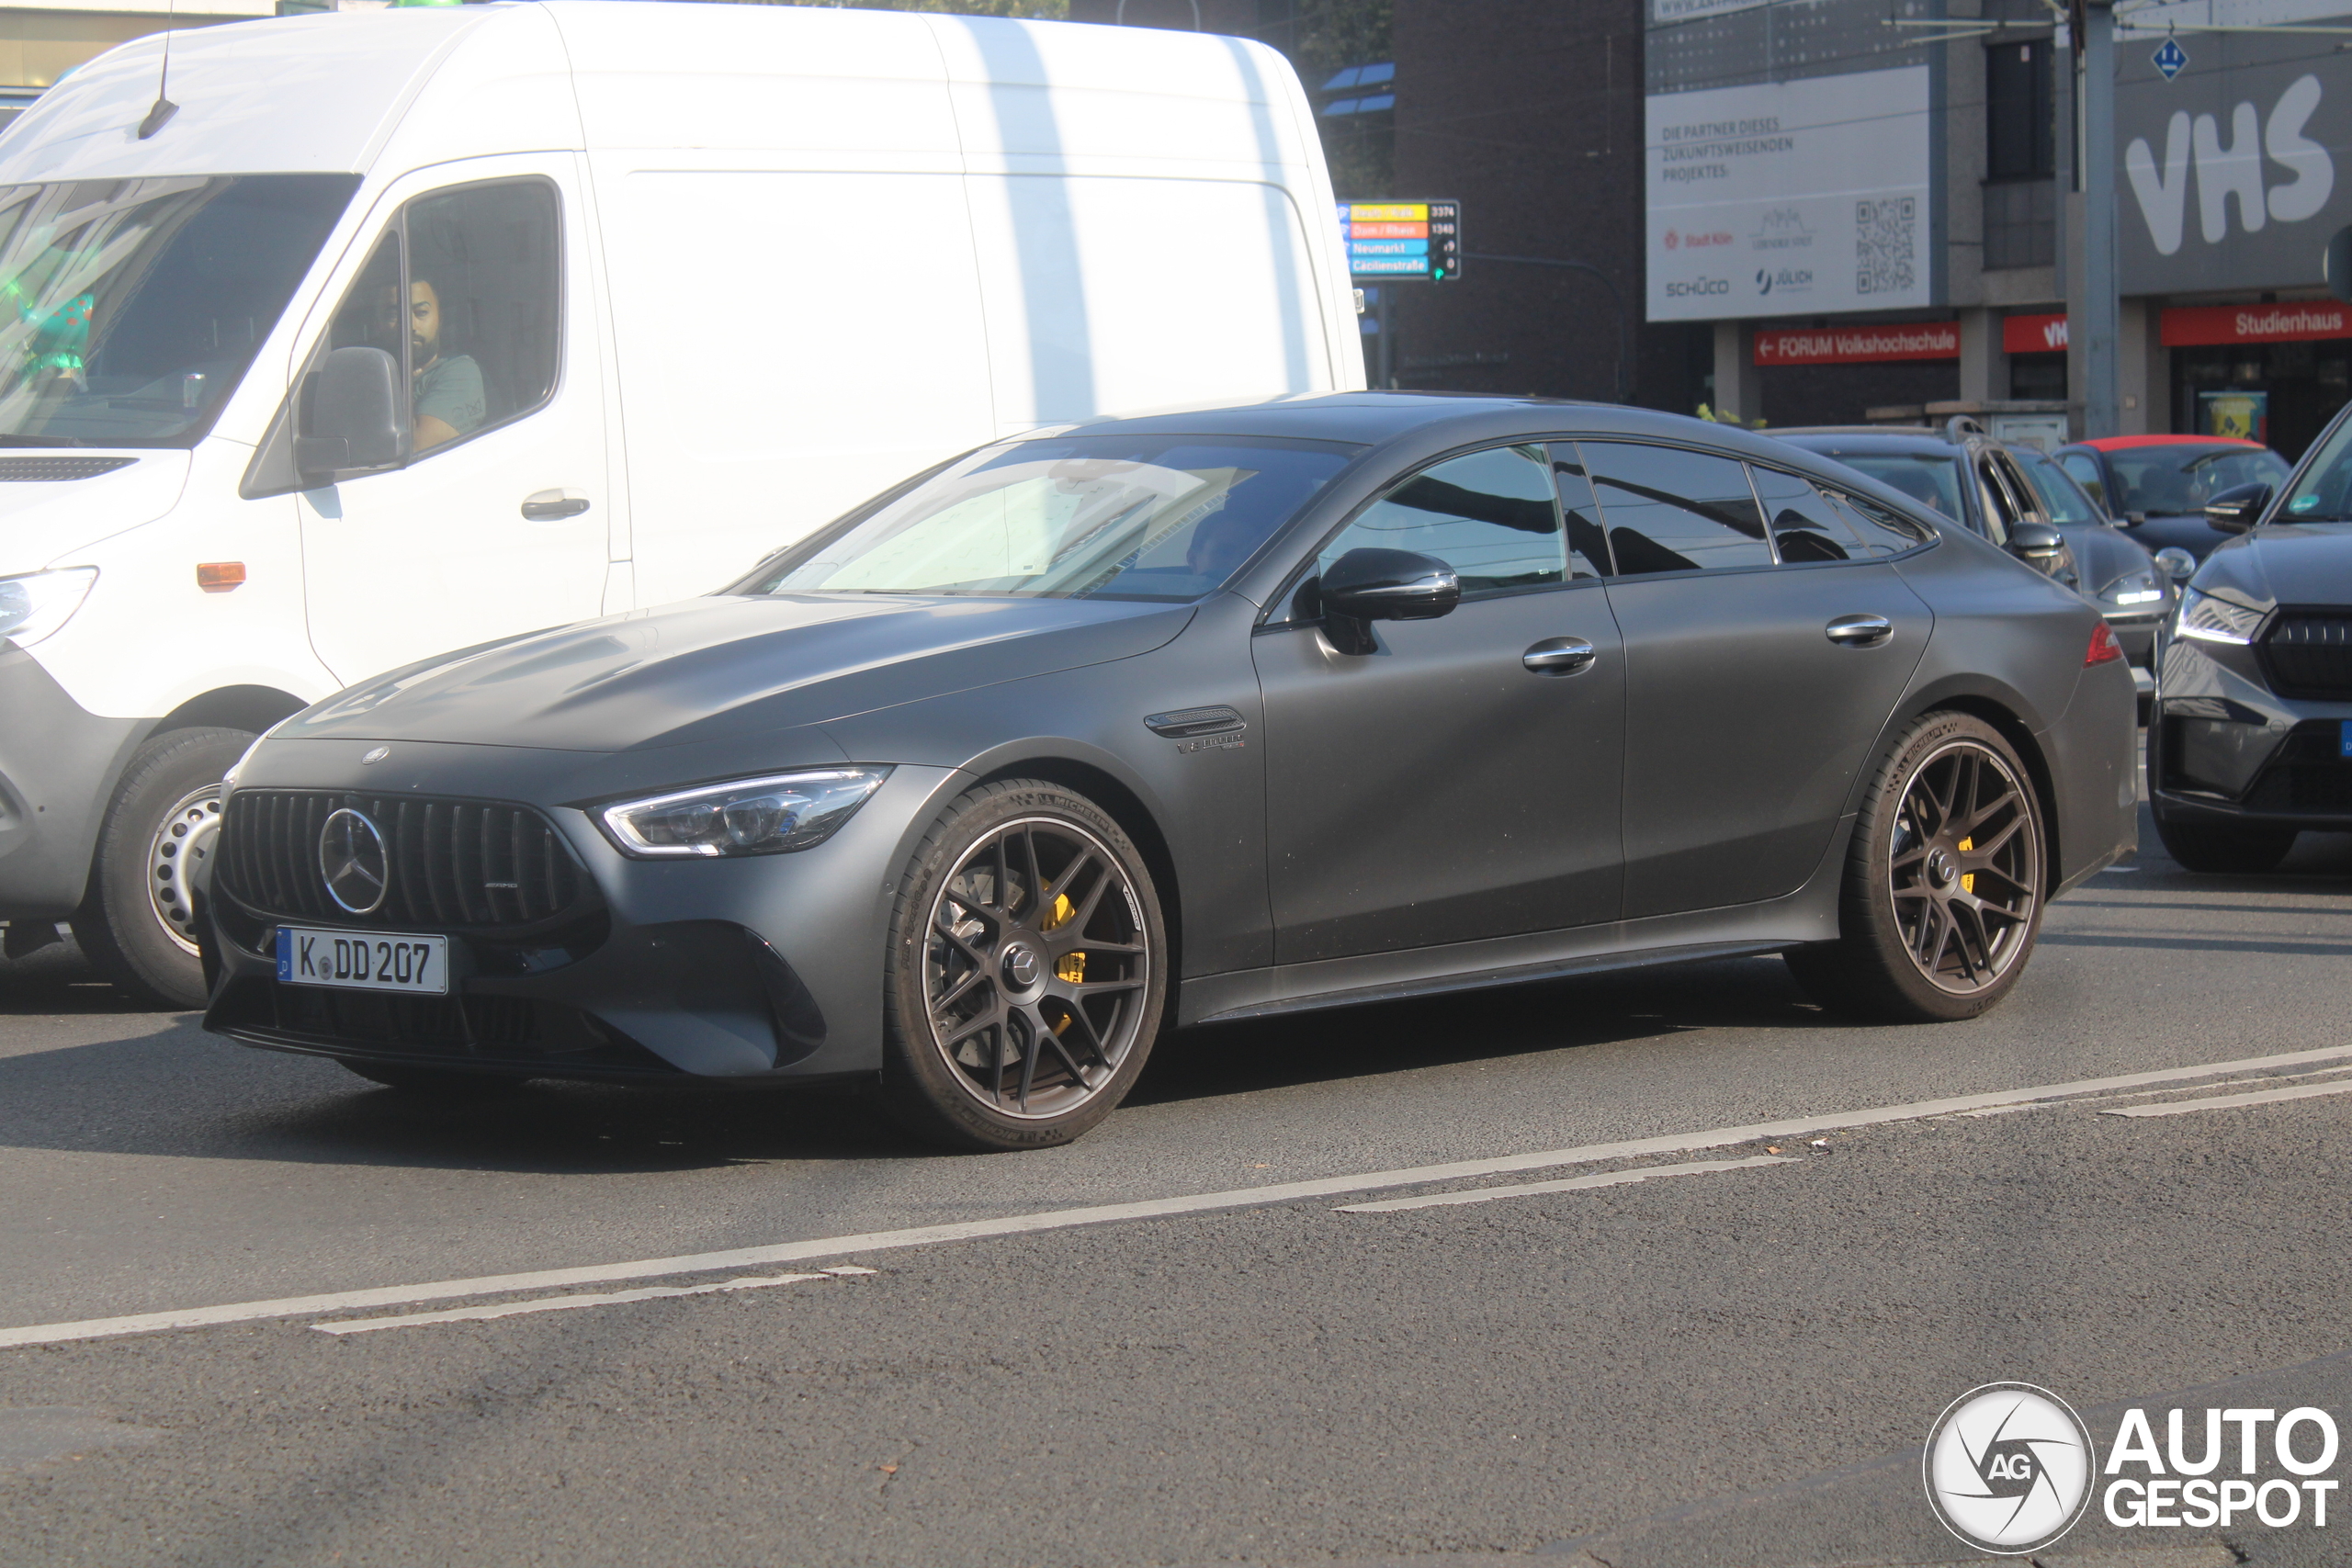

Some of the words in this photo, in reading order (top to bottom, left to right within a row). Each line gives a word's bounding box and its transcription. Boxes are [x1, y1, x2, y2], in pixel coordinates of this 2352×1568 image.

[1662, 127, 1681, 141] DIE
[1684, 120, 1736, 139] PARTNER
[1739, 117, 1780, 135] DIESES
[1662, 139, 1793, 162] ZUKUNFTSWEISENDEN
[2125, 73, 2335, 256] VHS
[1353, 243, 1406, 254] Neumarkt
[1353, 258, 1426, 271] Cäcilienstraße
[1666, 276, 1730, 298] SCHÜCO
[2043, 321, 2068, 348] VH
[2235, 311, 2343, 335] Studienhaus
[1779, 336, 1834, 357] FORUM
[1837, 330, 1957, 355] Volkshochschule
[1056, 795, 1115, 835] MICHELIN
[281, 960, 288, 973] D
[300, 935, 316, 976] K
[334, 938, 370, 981] DD
[376, 942, 430, 984] 207
